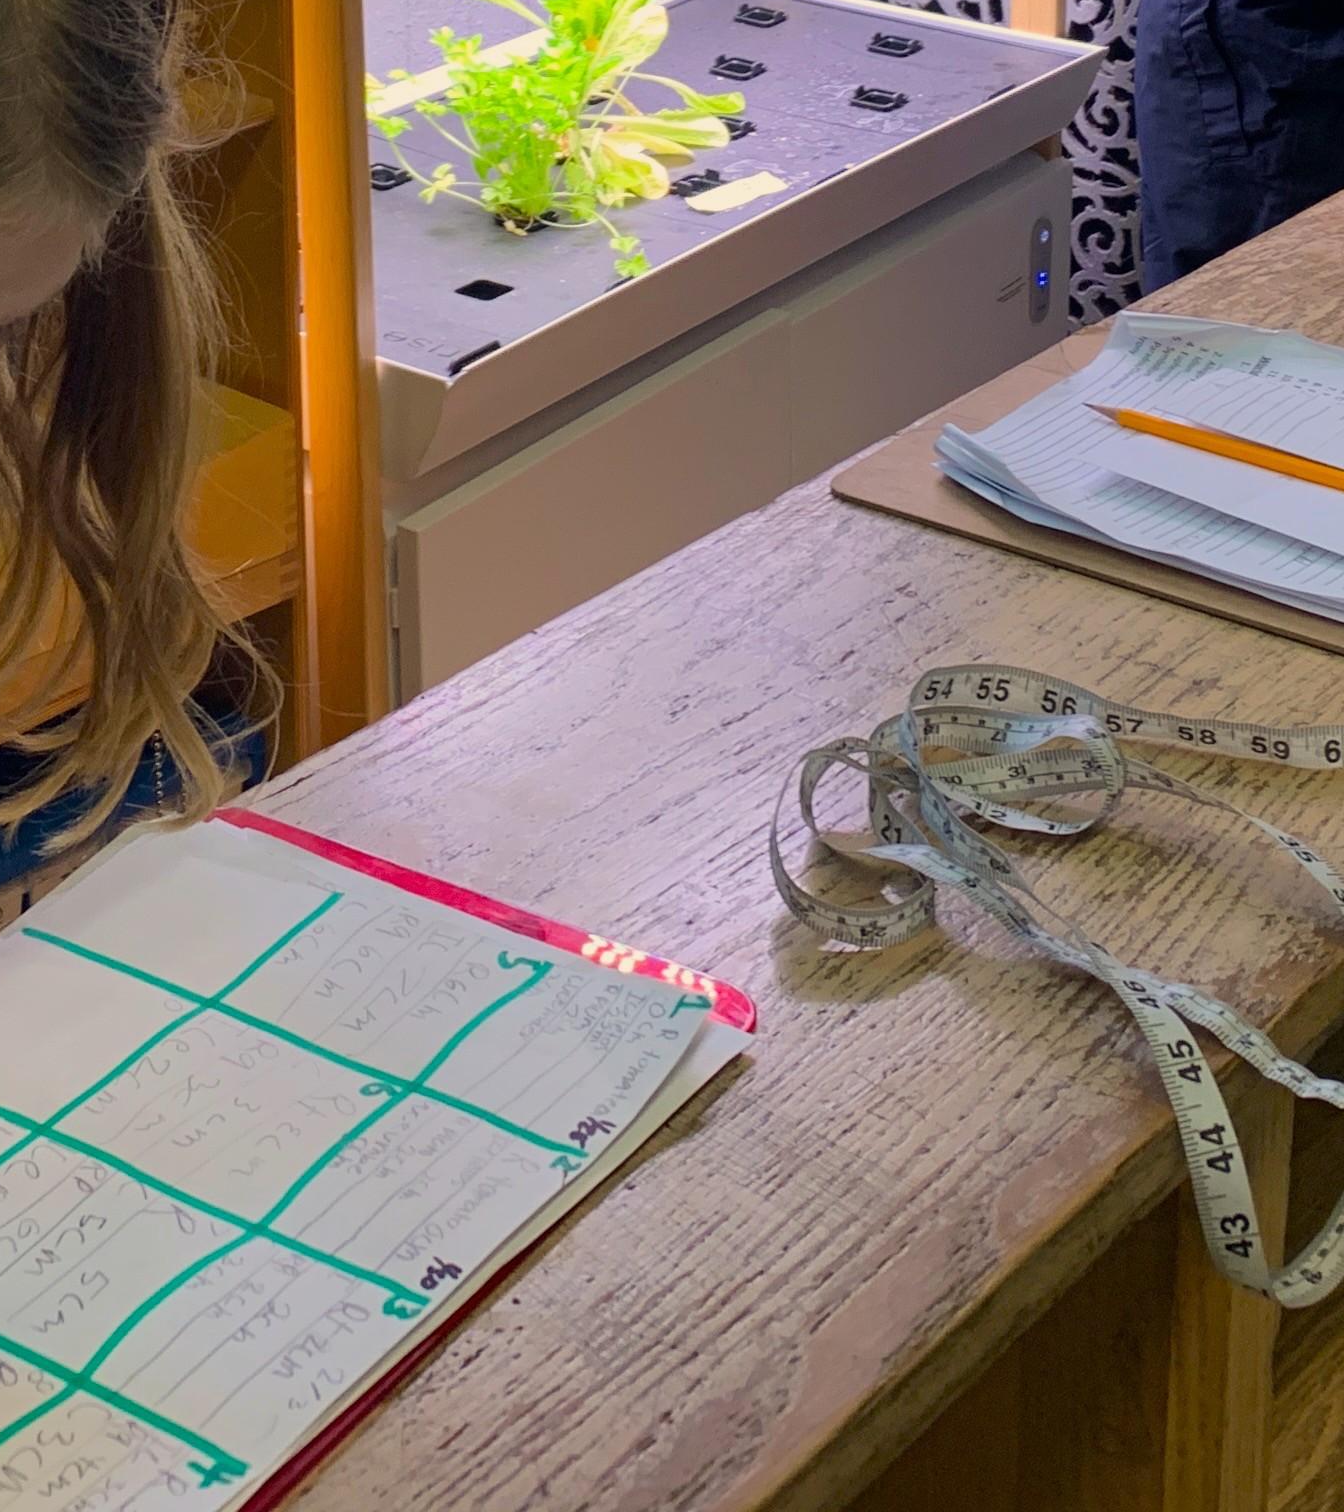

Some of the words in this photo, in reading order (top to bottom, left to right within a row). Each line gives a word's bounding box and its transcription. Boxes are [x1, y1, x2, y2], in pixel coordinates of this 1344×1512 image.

[923, 677, 955, 701] 54
[975, 677, 1011, 702] 55
[1039, 689, 1078, 716] 56
[1105, 713, 1144, 734] 57
[1177, 724, 1217, 747] 58
[1250, 735, 1291, 761] 59
[1122, 979, 1161, 1009] 46
[1168, 1039, 1203, 1084] 45
[1199, 1122, 1234, 1174] 44
[1219, 1211, 1254, 1259] 43
